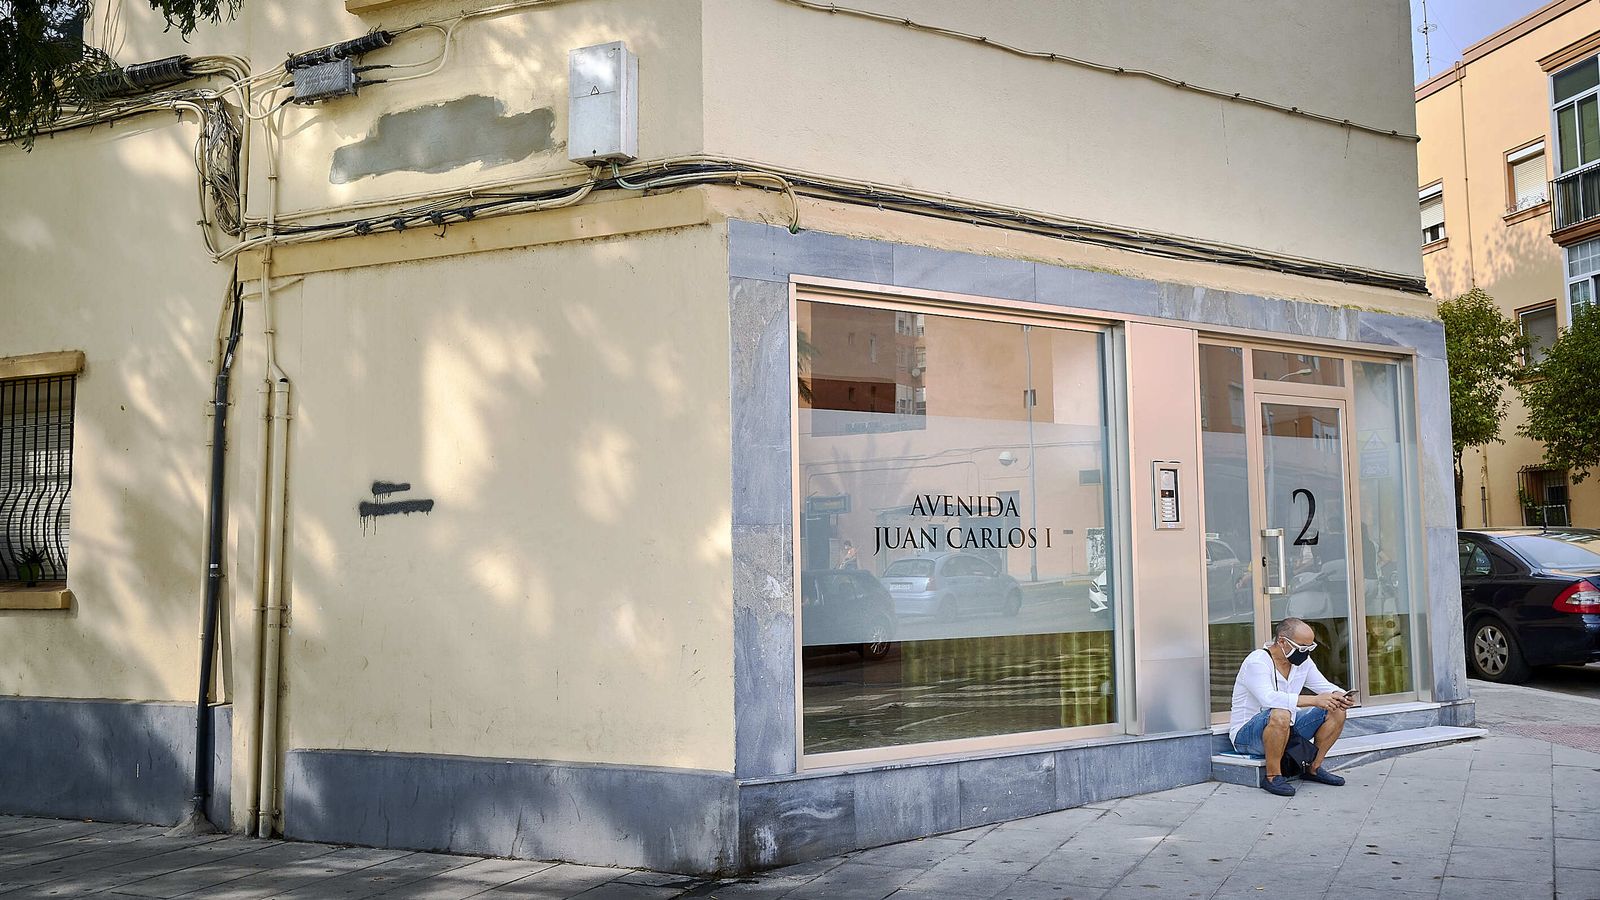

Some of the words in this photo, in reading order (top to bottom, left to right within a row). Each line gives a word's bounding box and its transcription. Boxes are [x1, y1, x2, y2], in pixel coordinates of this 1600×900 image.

[910, 494, 1021, 518] AVENIDA
[1292, 488, 1320, 546] 2
[873, 526, 938, 557] JUAN
[946, 527, 1038, 549] CARLOS
[1045, 527, 1052, 548] I
